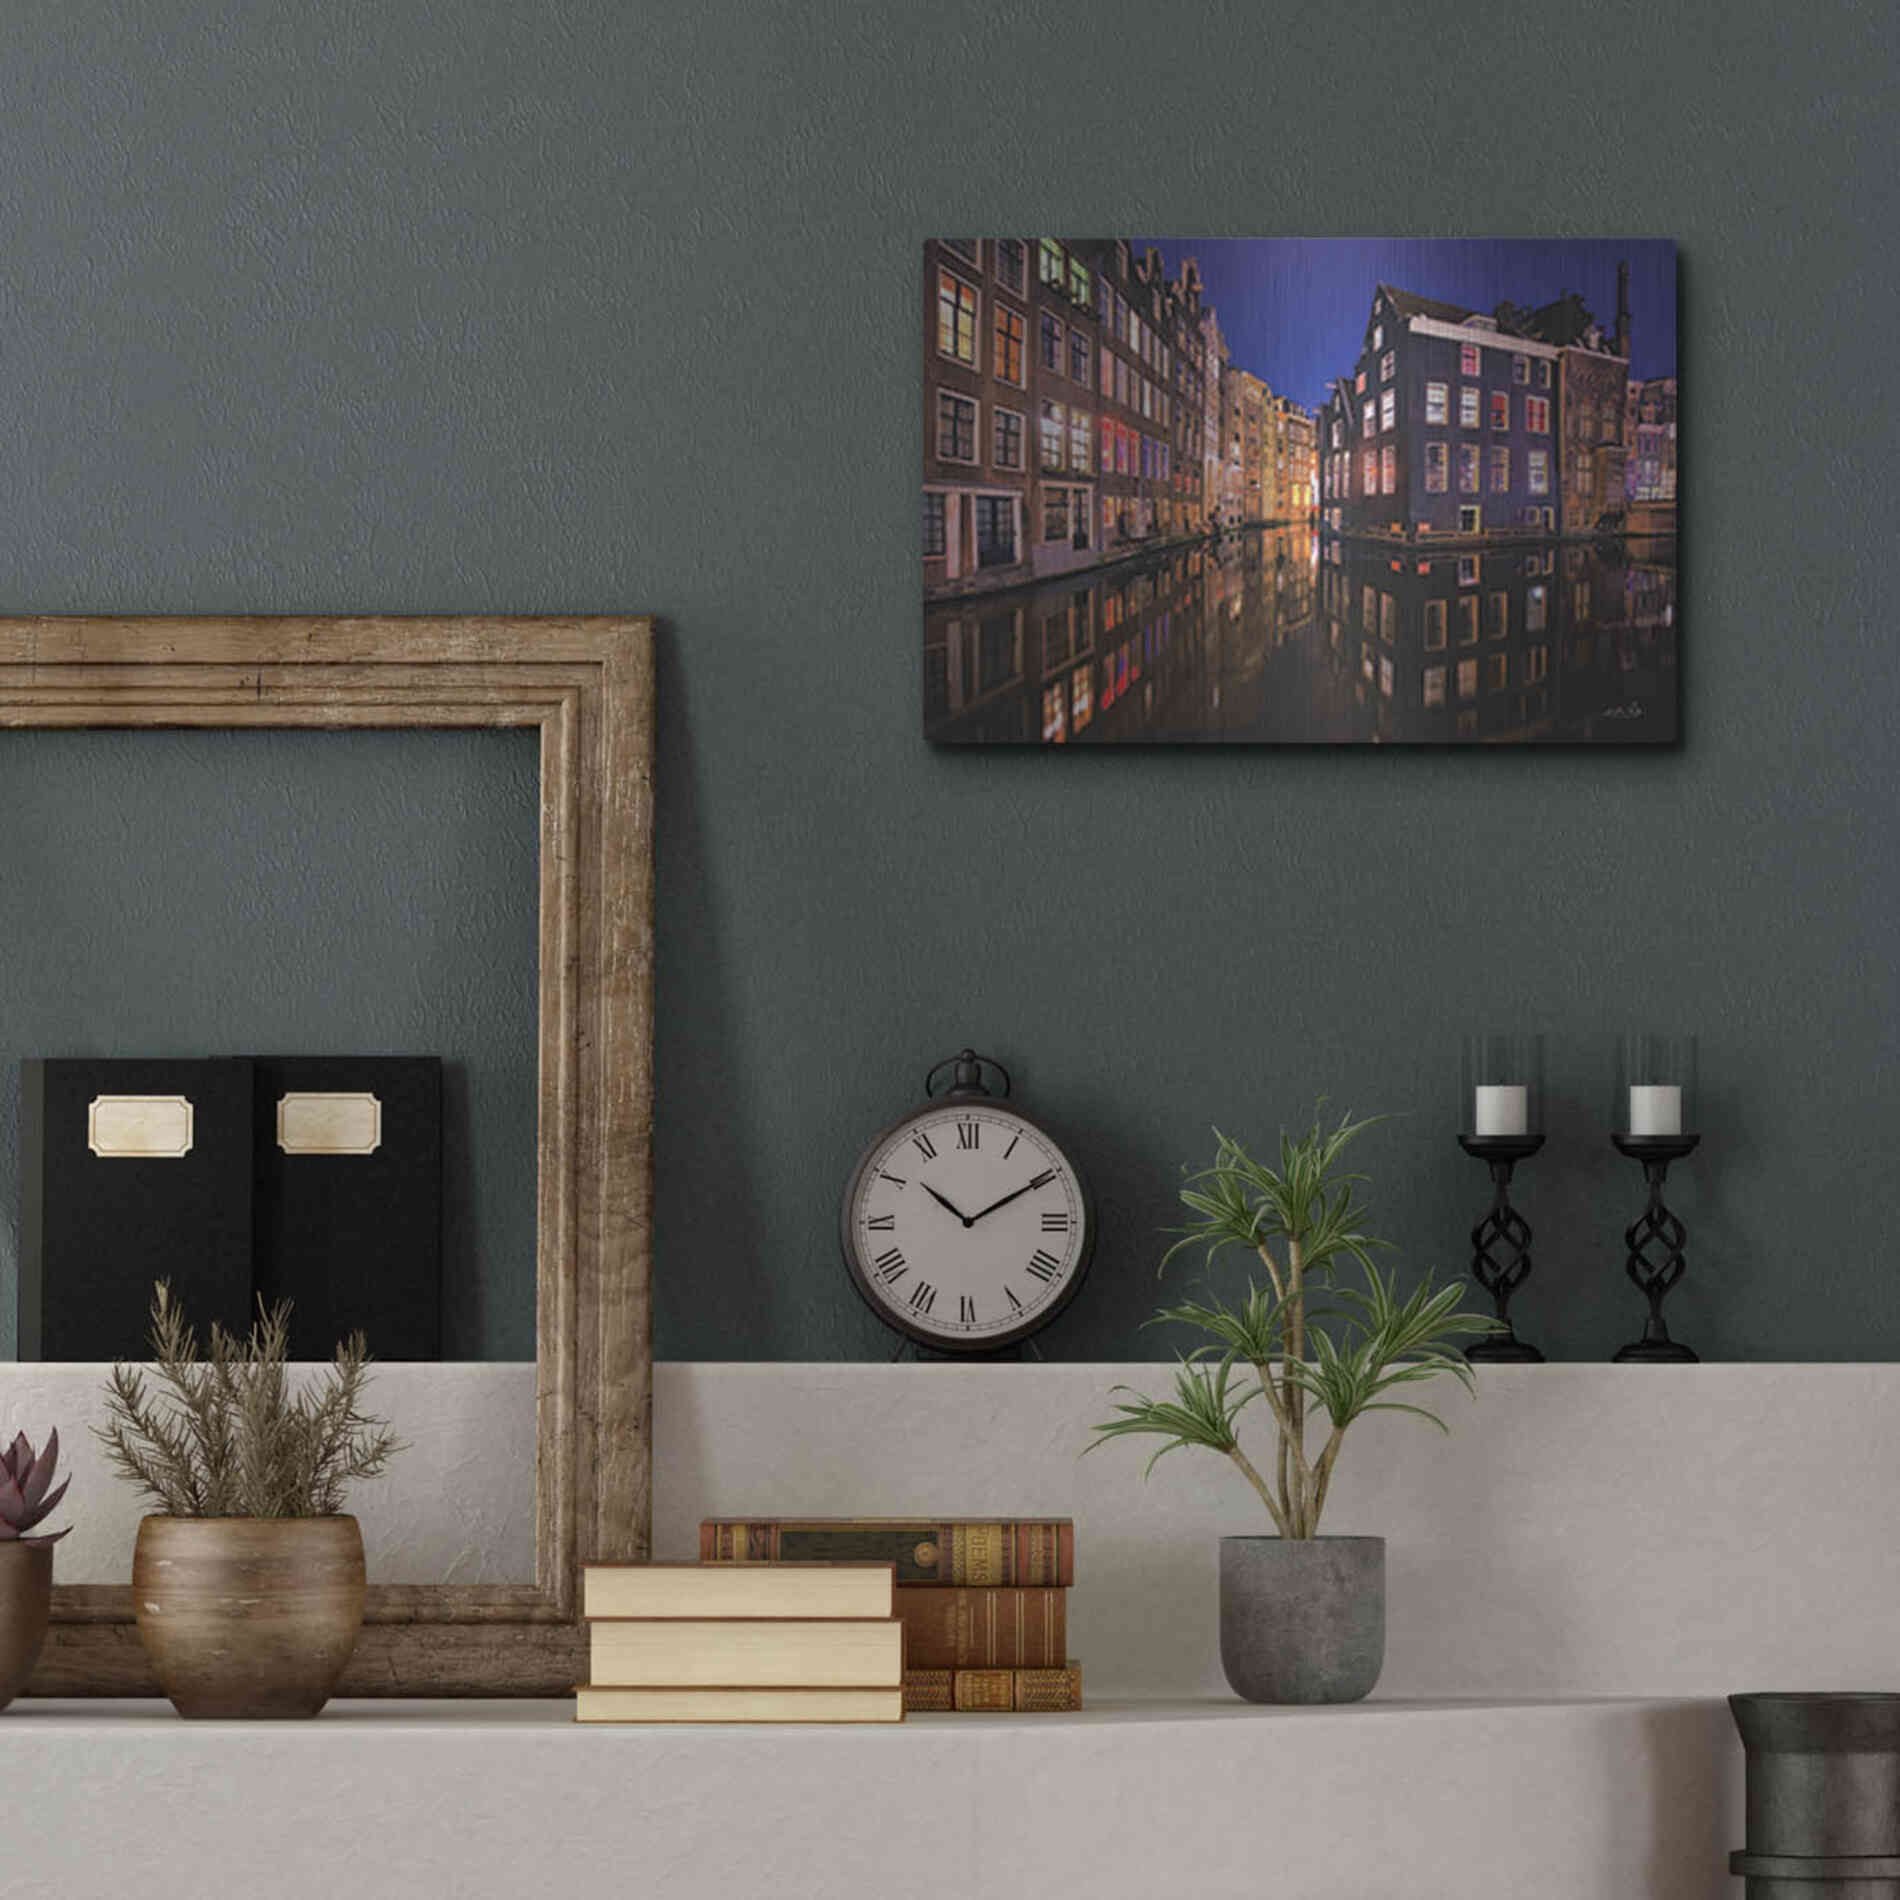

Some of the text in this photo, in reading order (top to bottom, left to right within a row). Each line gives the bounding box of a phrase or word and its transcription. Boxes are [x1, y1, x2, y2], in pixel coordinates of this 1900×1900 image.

[912, 1133, 938, 1163] XI
[956, 1123, 980, 1150] XII
[1003, 1136, 1019, 1160] I
[867, 1215, 895, 1231] IX
[1041, 1213, 1068, 1232] III
[875, 1247, 909, 1284] VIII
[1026, 1249, 1060, 1282] IIII
[909, 1281, 937, 1314] VII
[960, 1295, 976, 1323] VI
